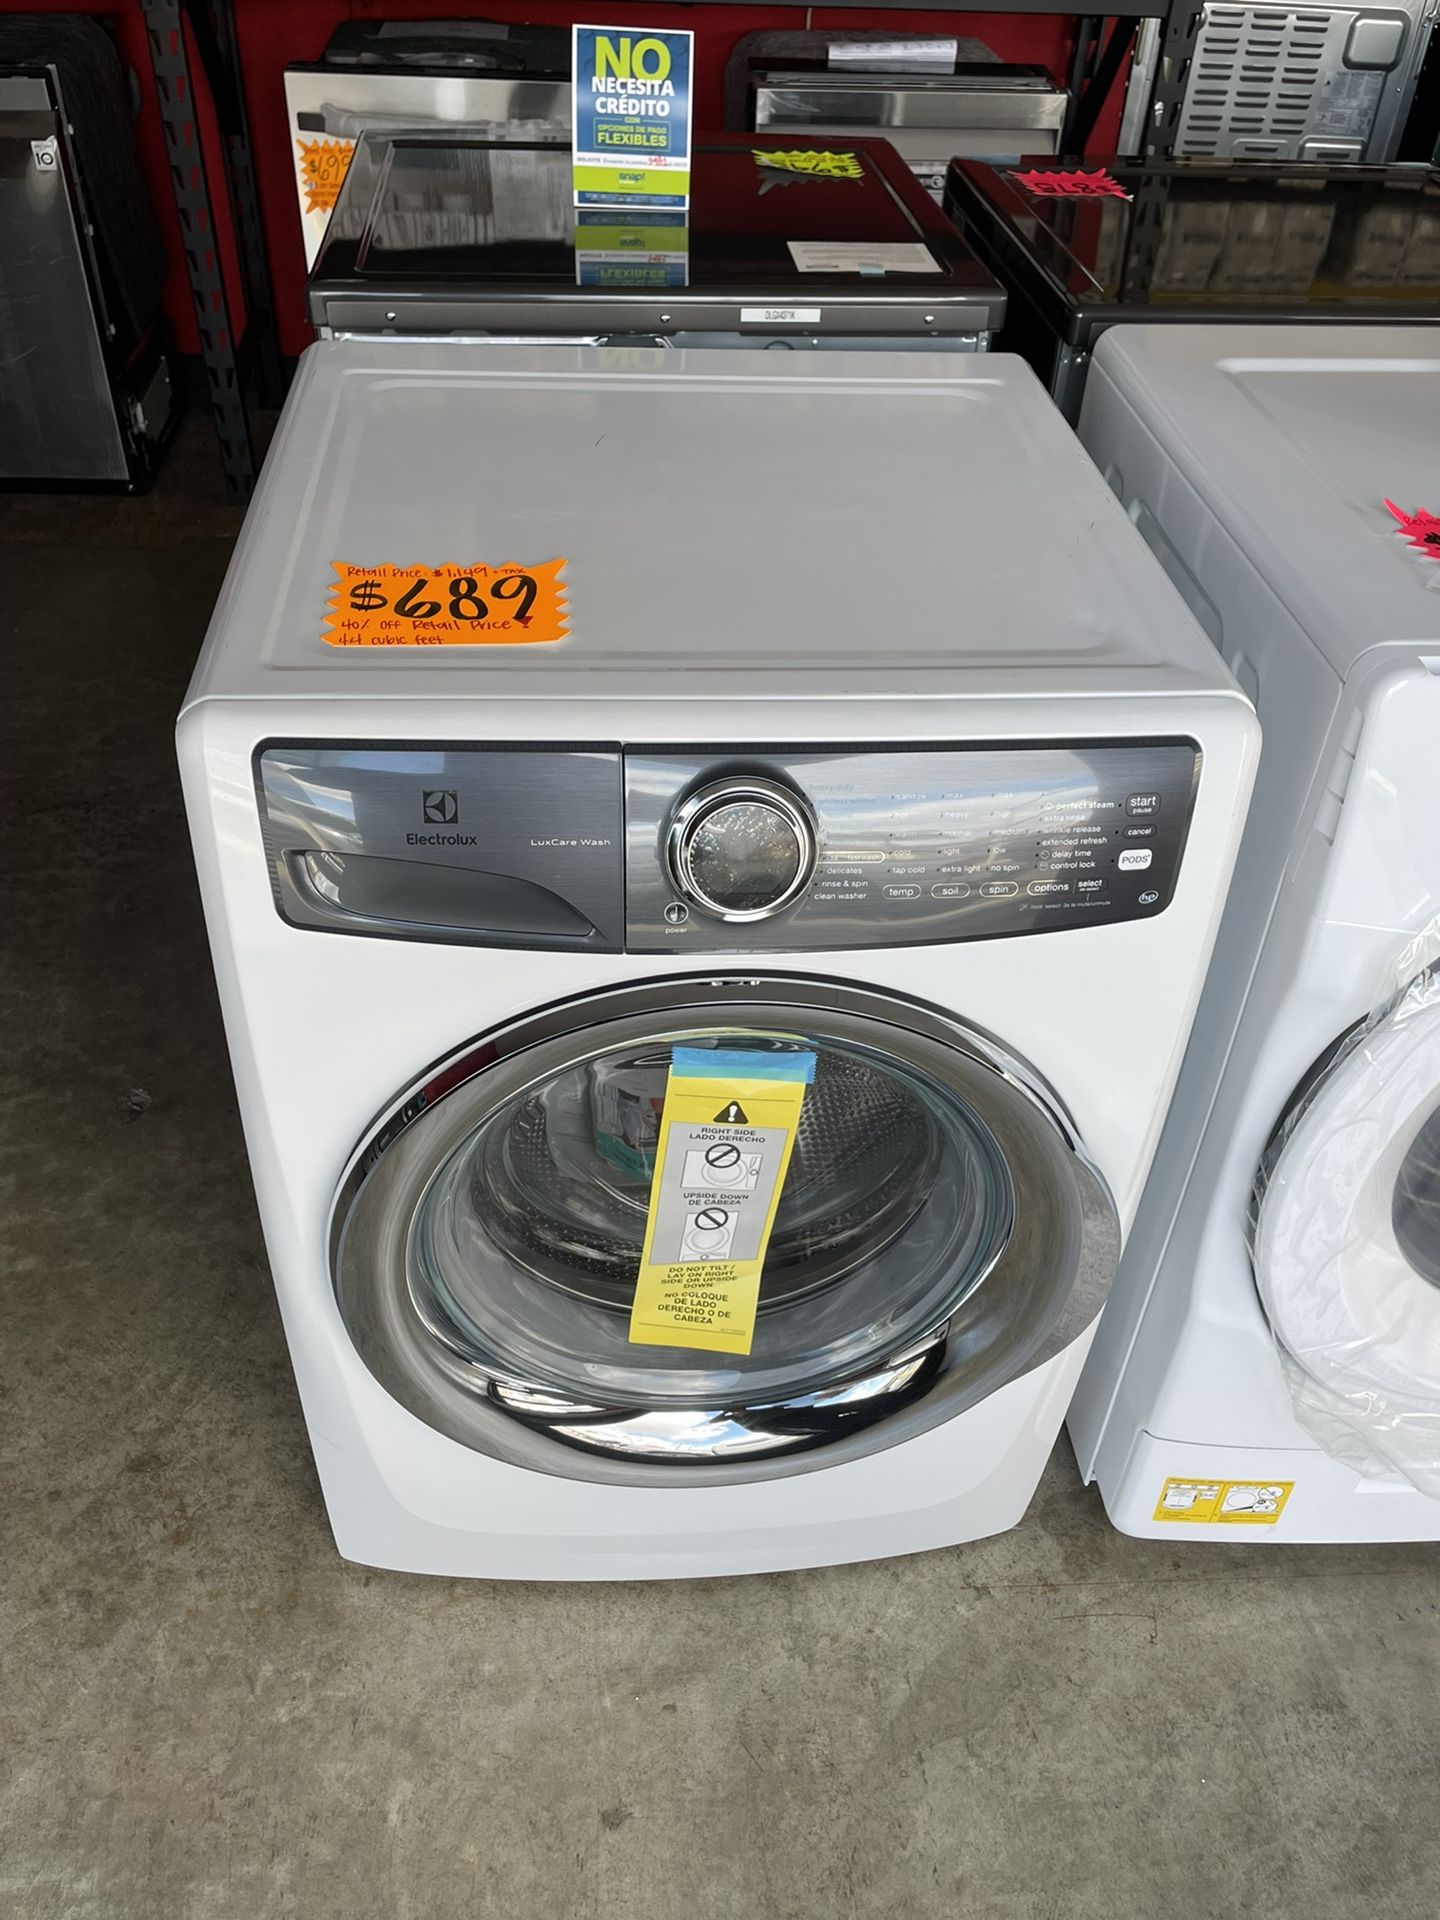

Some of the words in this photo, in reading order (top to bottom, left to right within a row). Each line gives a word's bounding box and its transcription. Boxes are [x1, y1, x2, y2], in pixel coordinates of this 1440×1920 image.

[595, 36, 671, 81] NO
[592, 76, 675, 96] NECESITA
[595, 94, 670, 116] CRÉDITO
[598, 132, 667, 147] FLEXIBLES
[347, 566, 387, 578] Retail
[349, 574, 537, 621] $689
[341, 619, 370, 630] 40%
[413, 620, 461, 630] Retail
[371, 635, 408, 645] cubic
[415, 634, 444, 645] feet
[1056, 801, 1087, 811] perfect
[1089, 801, 1115, 809] steam
[1130, 796, 1156, 806] start
[944, 811, 969, 820] heavy
[1127, 827, 1152, 836] cancel
[406, 833, 479, 846] Electrolux
[530, 838, 577, 846] LuxCare
[580, 838, 611, 846] Wash
[1041, 838, 1079, 846] extended
[1080, 836, 1108, 845] refresh
[893, 848, 912, 857] cold
[1051, 850, 1074, 860] delay
[893, 865, 908, 874] tap
[907, 864, 926, 873] cold
[942, 864, 962, 873] extra
[964, 863, 981, 874] light
[1003, 863, 1020, 873] spin
[1050, 862, 1078, 870] control
[1079, 860, 1096, 869] lock
[826, 867, 863, 875] delicates
[851, 880, 869, 889] spin
[1034, 883, 1070, 893] options
[1078, 879, 1103, 888] select
[889, 888, 914, 897] temp
[942, 886, 959, 895] soil
[988, 885, 1009, 896] spin
[814, 892, 836, 901] clean
[838, 892, 867, 901] washer
[664, 927, 688, 935] power
[701, 1127, 731, 1135] RIGHT
[689, 1133, 716, 1141] LADO
[718, 1135, 766, 1143] DERECHO
[683, 1192, 718, 1200] UPSIDE
[681, 1291, 729, 1302] COLOQUE
[690, 1299, 717, 1309] LADO
[658, 1304, 705, 1315] DERECHO
[708, 1309, 715, 1317] O
[674, 1314, 713, 1325] CABEZA
